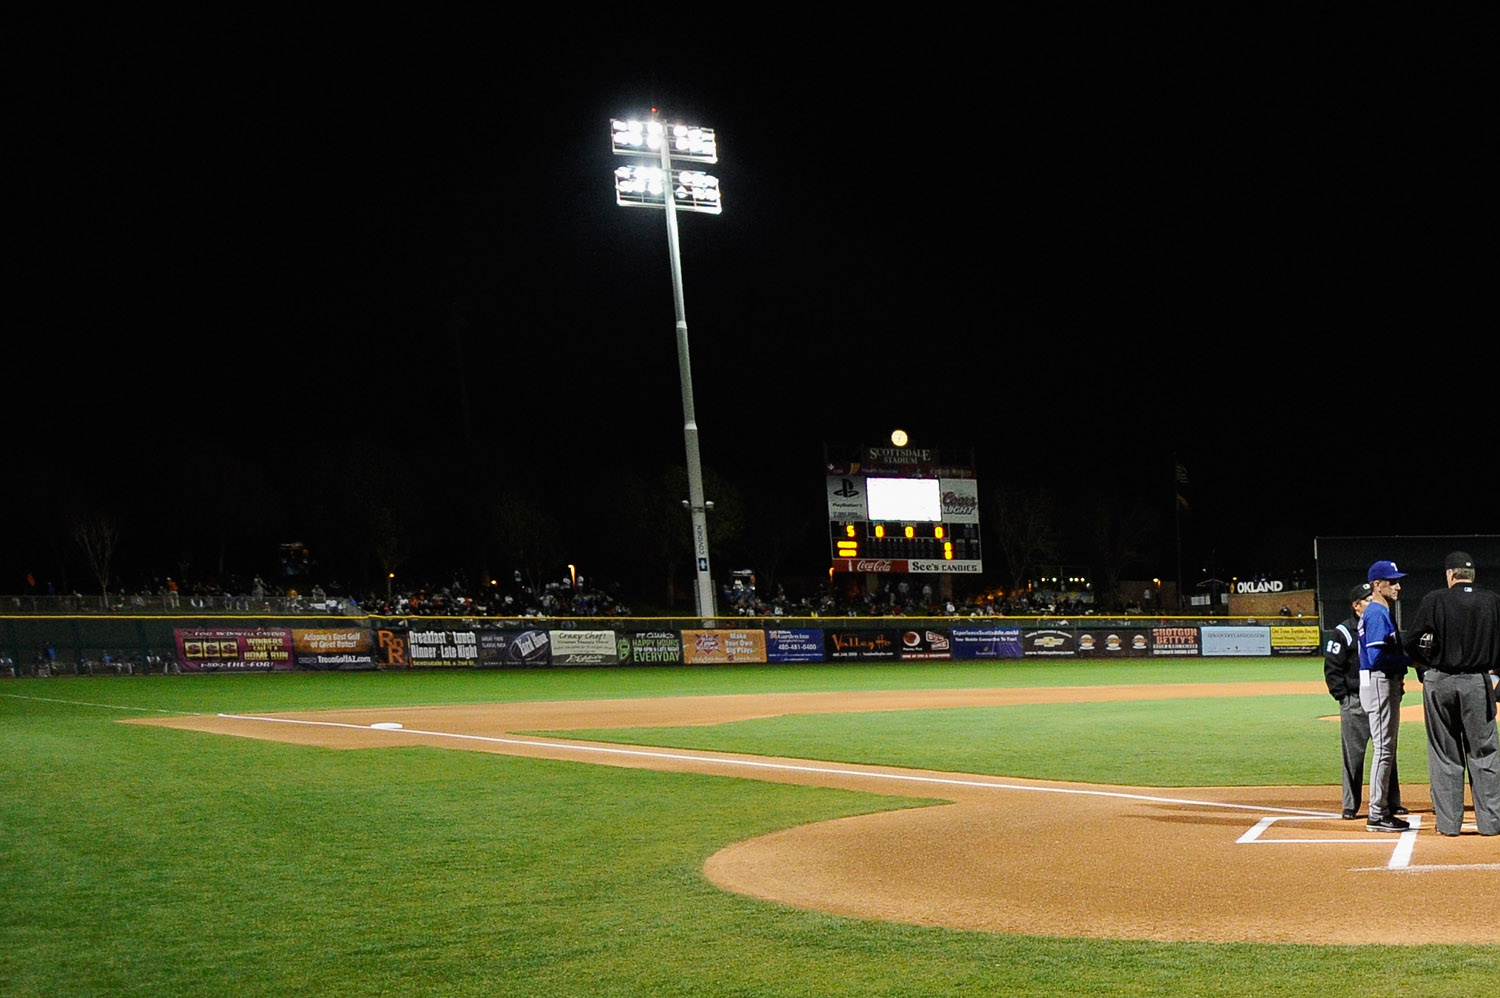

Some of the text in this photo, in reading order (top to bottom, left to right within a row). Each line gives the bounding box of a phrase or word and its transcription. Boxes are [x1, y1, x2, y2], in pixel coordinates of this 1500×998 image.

[870, 448, 930, 461] SCOTTSDALE
[943, 491, 976, 507] Coors
[944, 506, 976, 514] LIGHT
[912, 562, 978, 572] See's CANDIES
[1237, 581, 1283, 594] OKLAND
[348, 632, 360, 640] Golf
[1153, 628, 1198, 636] SHOTGUN
[409, 631, 476, 644] Breakfast Lunch
[1156, 636, 1195, 645] BETTY'S
[632, 639, 655, 647] HAPPY
[1326, 640, 1341, 655] 13
[411, 646, 478, 660] Dinner Late Night
[634, 652, 680, 662] EVERYDAY
